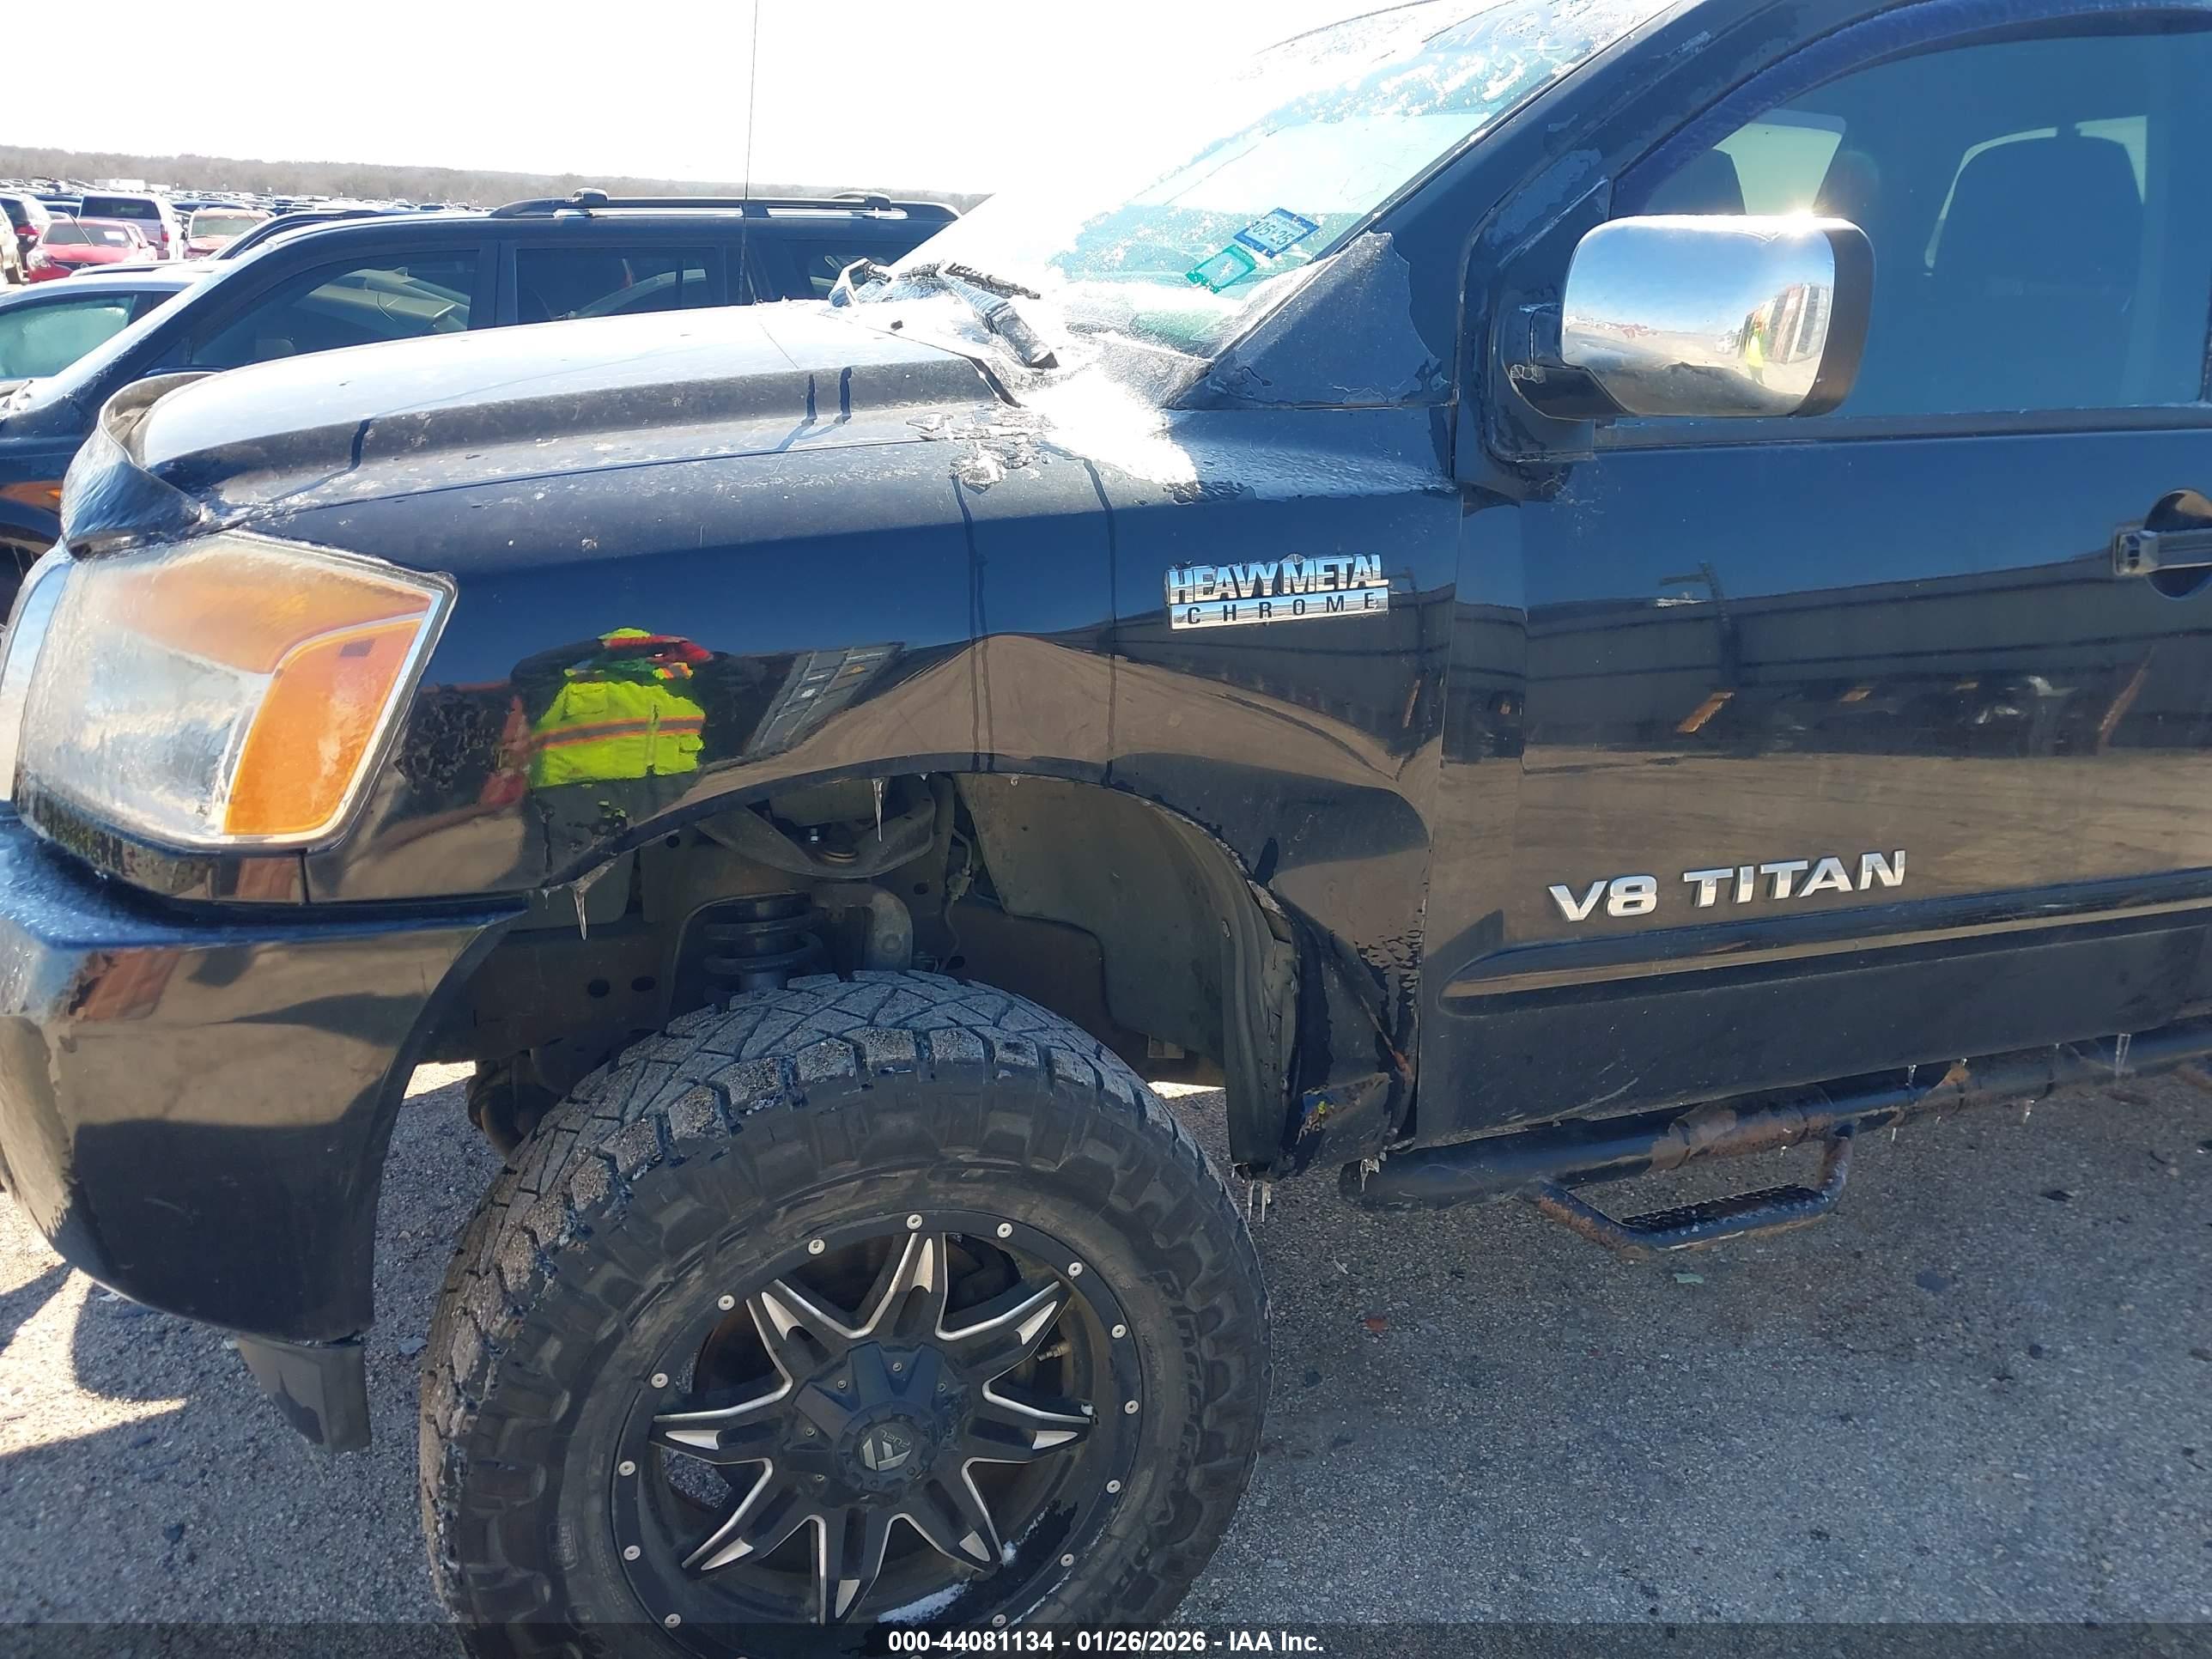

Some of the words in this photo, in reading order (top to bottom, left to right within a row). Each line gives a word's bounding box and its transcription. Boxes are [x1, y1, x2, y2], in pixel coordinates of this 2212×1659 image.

[1168, 559, 1279, 605] HEAVY
[1283, 554, 1389, 592] METAL
[1187, 592, 1379, 624] CHROME
[1547, 875, 1657, 922] V8
[1682, 849, 1906, 908] TITAN
